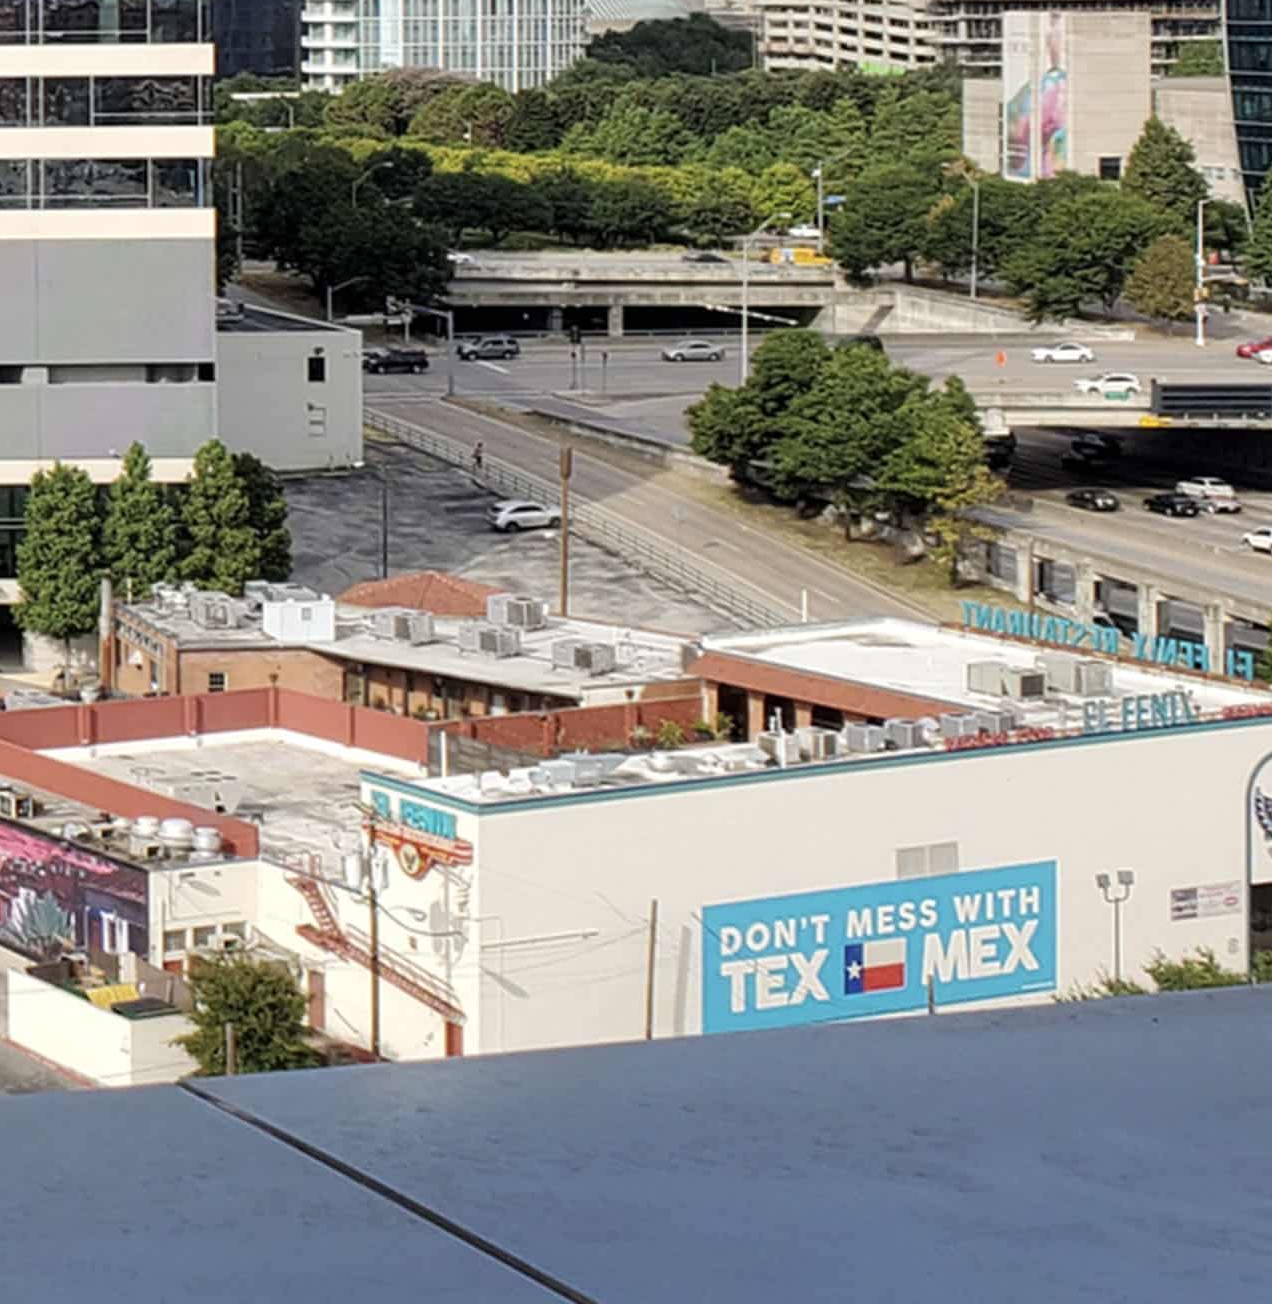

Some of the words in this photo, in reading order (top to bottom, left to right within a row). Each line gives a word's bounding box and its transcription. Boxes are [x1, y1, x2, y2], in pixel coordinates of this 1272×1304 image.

[719, 914, 830, 956] DON'T
[846, 899, 938, 939] MESS
[953, 885, 1040, 923] WITH
[720, 948, 830, 1013] TEX
[921, 919, 1040, 987] MEX
